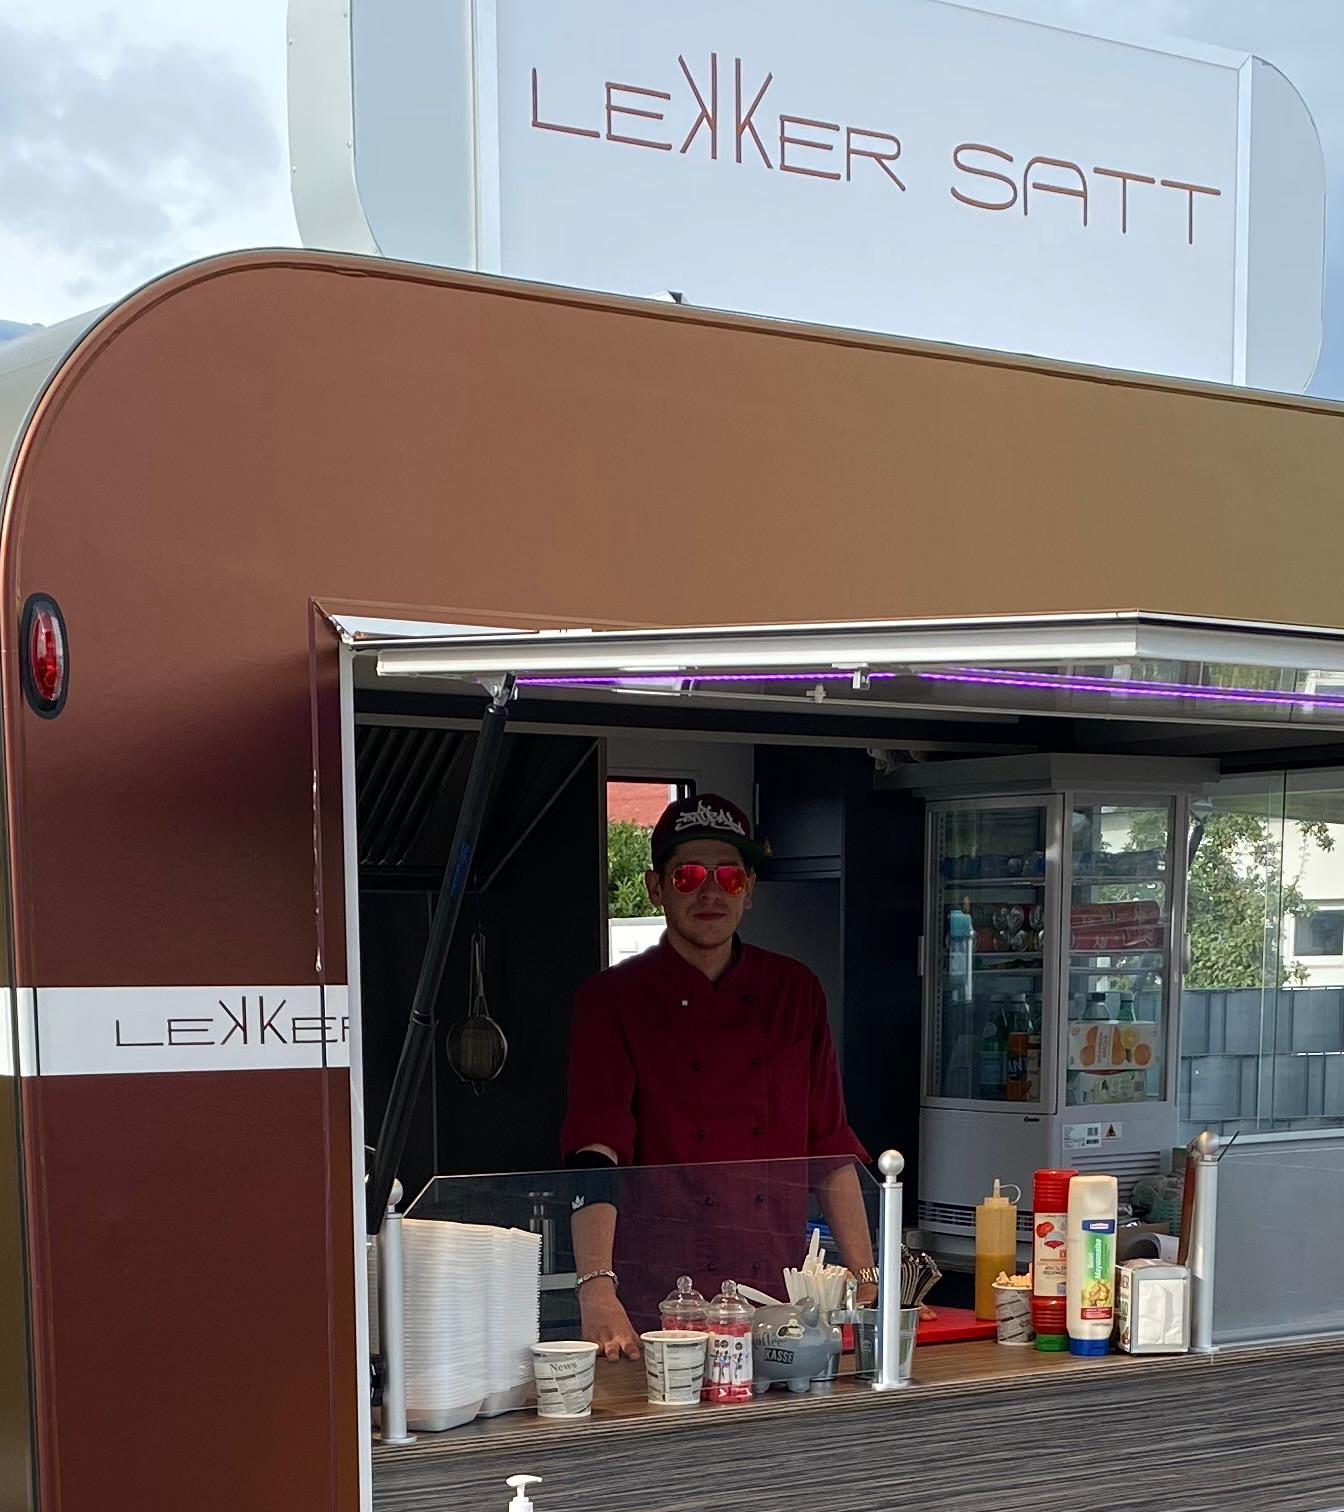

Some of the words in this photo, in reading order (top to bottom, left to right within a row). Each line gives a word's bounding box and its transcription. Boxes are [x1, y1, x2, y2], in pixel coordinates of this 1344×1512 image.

[531, 52, 906, 192] LEKKER
[950, 143, 1222, 245] SATT
[115, 996, 350, 1047] LEKKE
[550, 1362, 578, 1372] News
[765, 1349, 793, 1364] KASSE
